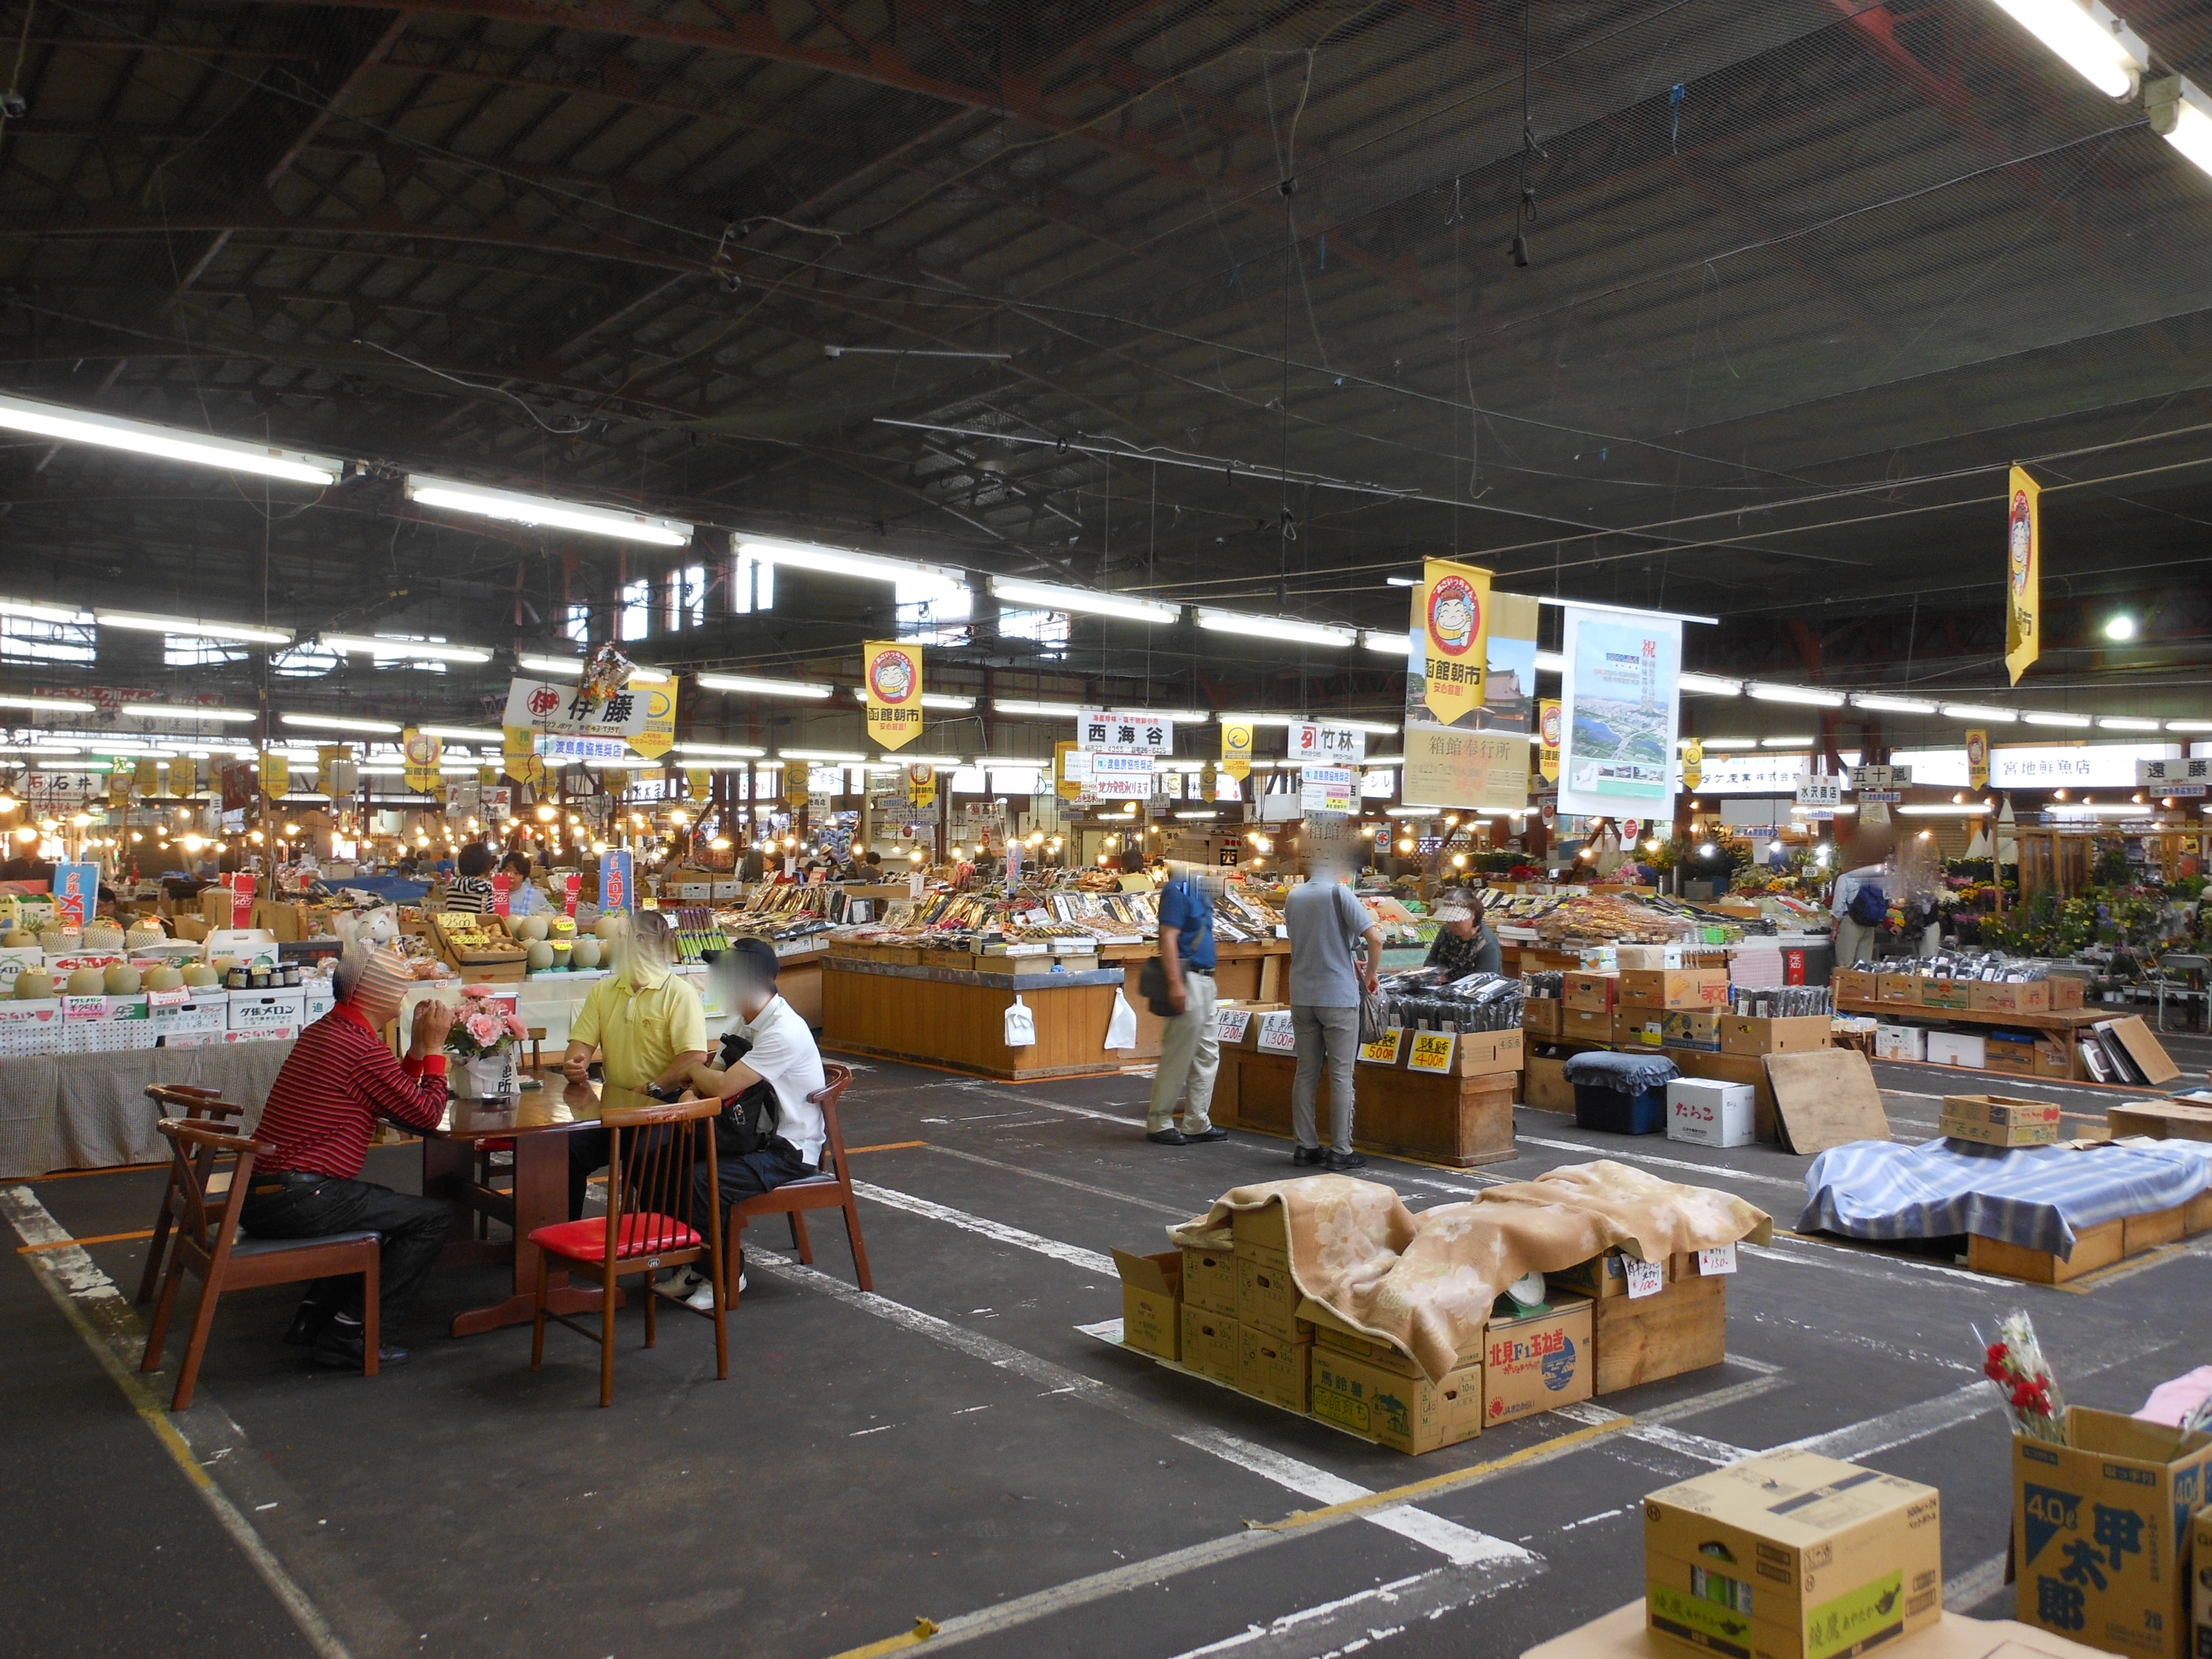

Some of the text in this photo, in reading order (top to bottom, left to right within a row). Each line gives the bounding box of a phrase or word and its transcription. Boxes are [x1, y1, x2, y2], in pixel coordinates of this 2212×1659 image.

[1641, 639, 1657, 658] 祝
[1426, 657, 1481, 685] 函館朝市
[868, 708, 919, 722] 函館朝市
[1088, 724, 1163, 745] 西海谷
[1321, 728, 1354, 752] 竹林
[556, 740, 621, 758] 渡島農協推奨店
[1429, 736, 1511, 760] 箱館奉行所
[1853, 767, 1907, 782] 五十嵐
[2003, 759, 2091, 776] 宮地鮮魚店
[2147, 760, 2207, 779] 遠藤
[54, 775, 93, 790] 石井
[1098, 781, 1149, 794] 地方発送承ります
[1801, 786, 1837, 798] 水沢商店
[1701, 987, 1727, 1004] Dole
[70, 1003, 102, 1012] ¥2500
[239, 1006, 295, 1015] 夕張メロン
[312, 1002, 323, 1013] 追
[1368, 1046, 1394, 1061] 500円
[1416, 1053, 1444, 1067] 400円
[1676, 1103, 1714, 1122] たらこ
[1489, 1328, 1563, 1368] 北見F1玉ねぎ
[1322, 1370, 1363, 1398] 馬鈴薯
